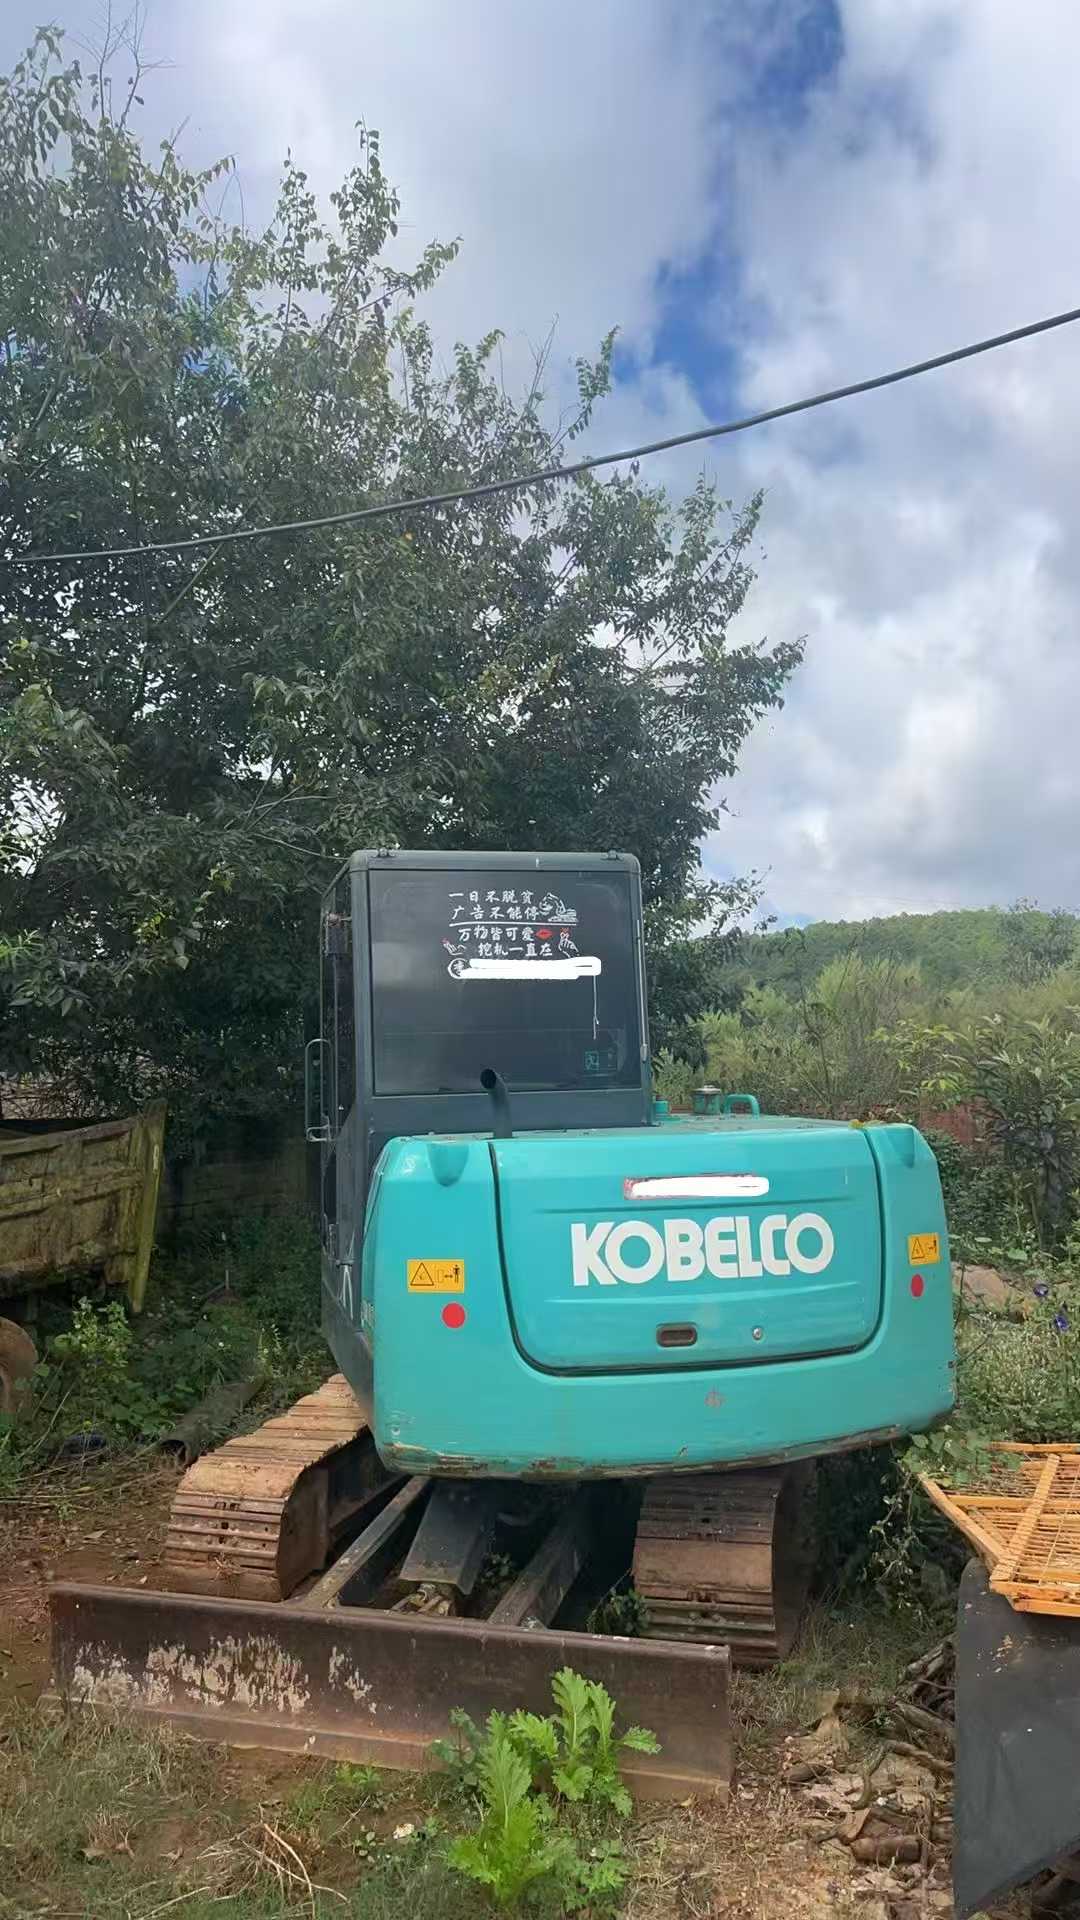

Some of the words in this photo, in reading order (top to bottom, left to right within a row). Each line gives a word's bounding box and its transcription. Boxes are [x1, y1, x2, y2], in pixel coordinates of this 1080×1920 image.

[451, 905, 541, 921] 广告不能停
[458, 925, 535, 942] 万物皆可爱
[571, 1212, 834, 1287] KOBELCO
